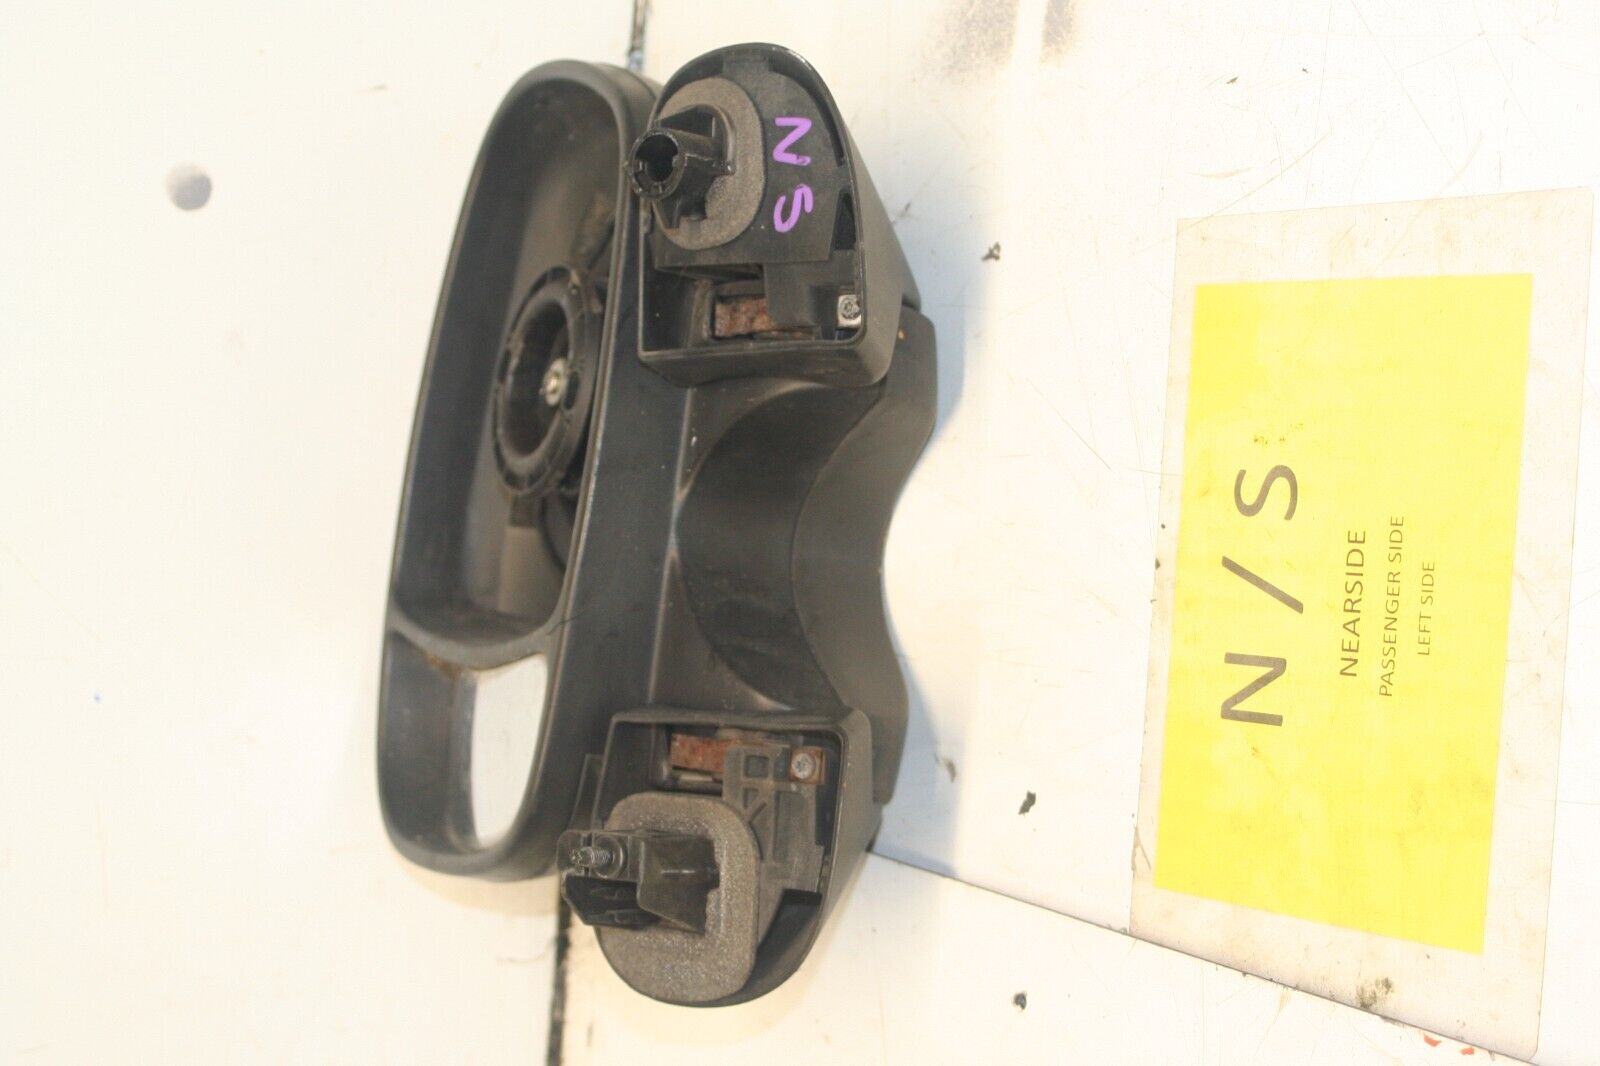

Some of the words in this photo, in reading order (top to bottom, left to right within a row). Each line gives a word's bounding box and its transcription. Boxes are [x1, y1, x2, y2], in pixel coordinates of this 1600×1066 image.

[1388, 516, 1405, 564] SIDE
[1340, 530, 1366, 677] NEARSIDE
[1421, 561, 1436, 606] SIDE
[1379, 571, 1402, 697] PASSENGER
[1417, 611, 1432, 656] LEFT
